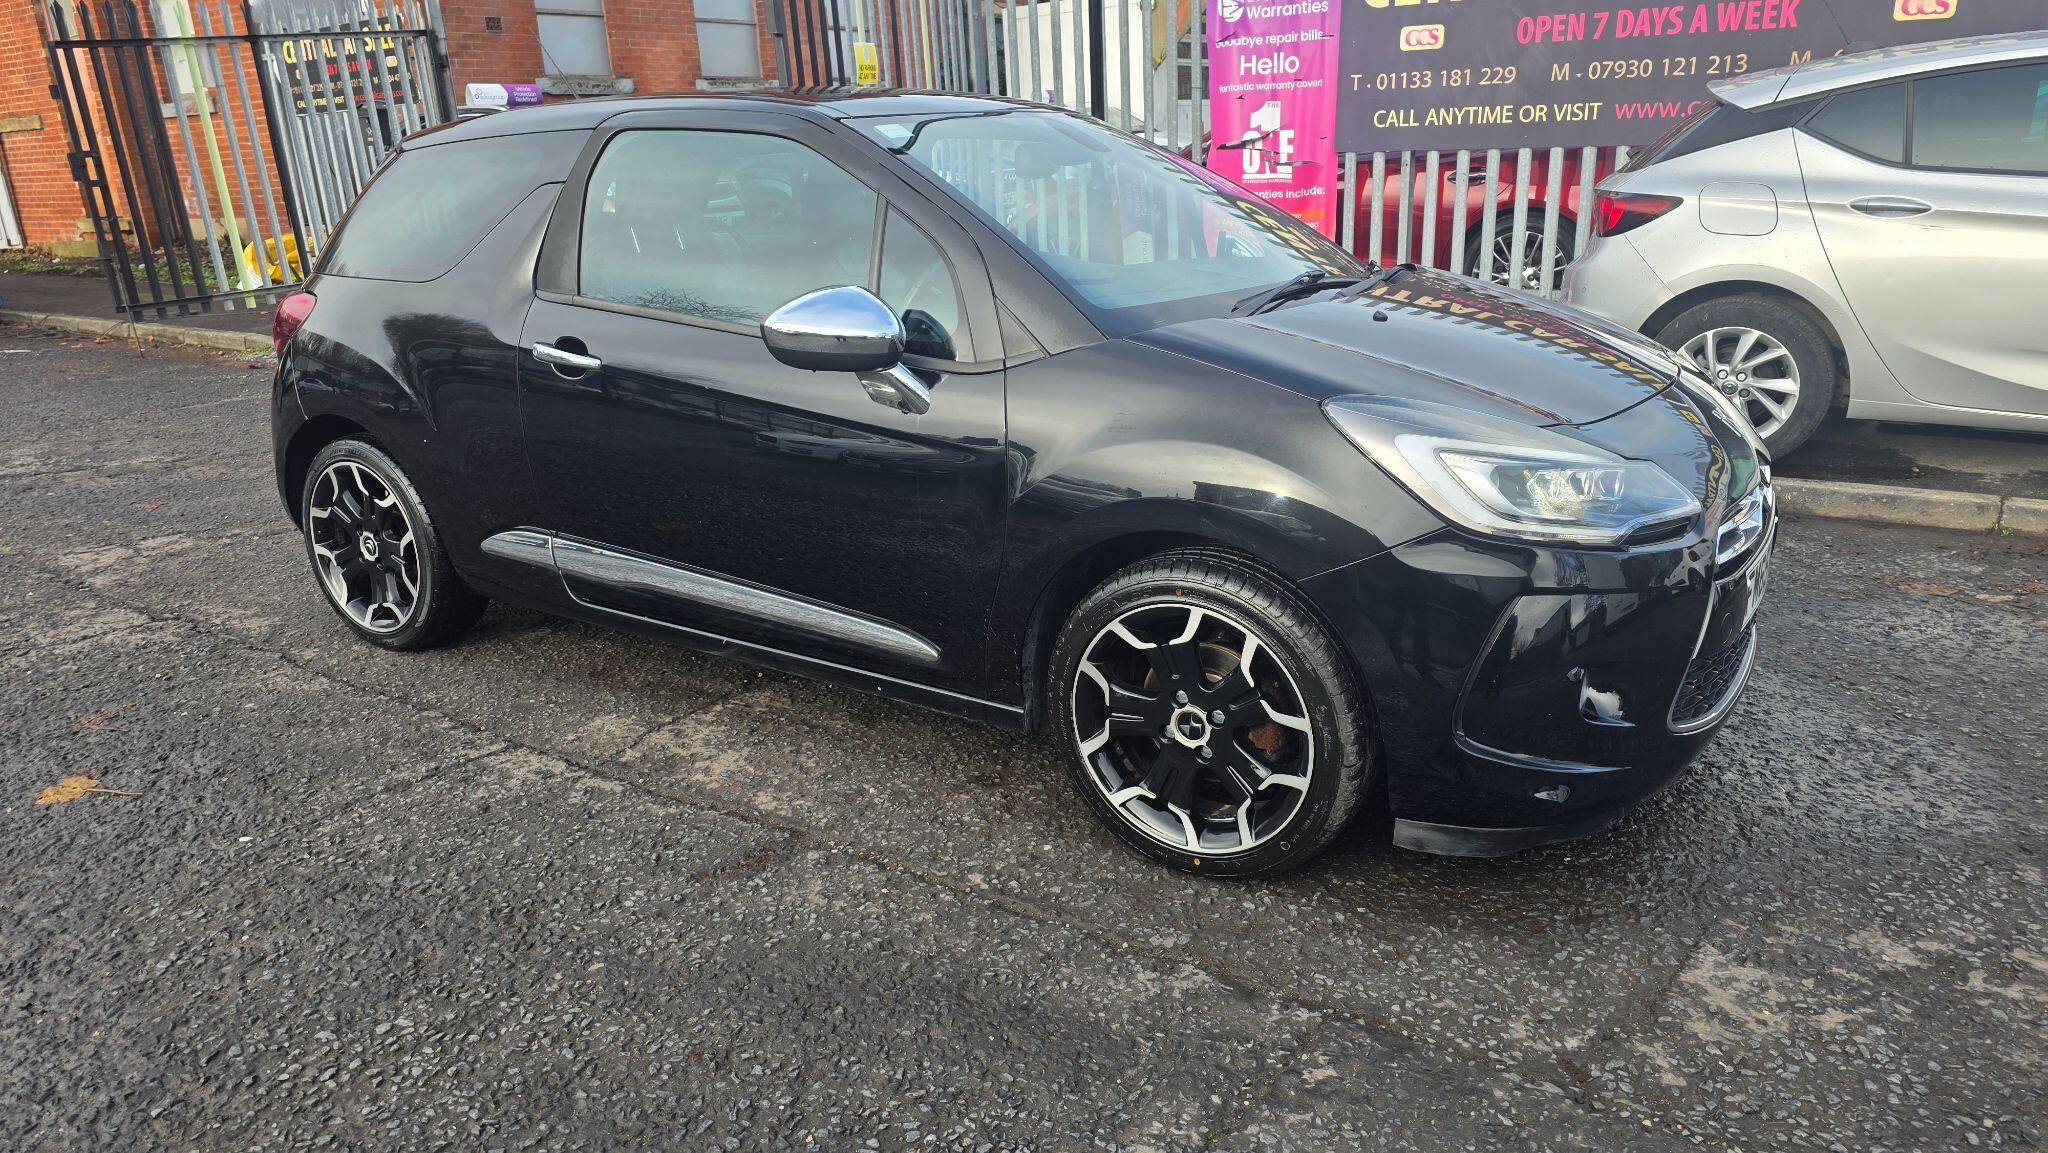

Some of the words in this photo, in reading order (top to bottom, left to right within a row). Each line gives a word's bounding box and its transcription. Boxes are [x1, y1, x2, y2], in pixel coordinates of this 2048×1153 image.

[1247, 1, 1328, 19] Warranties
[1516, 13, 1586, 44] OPEN
[1592, 12, 1609, 40] 7
[1615, 6, 1684, 39] DAYS
[1688, 3, 1707, 34] A
[1717, 0, 1800, 32] WEEK
[1265, 31, 1298, 47] repair
[1240, 51, 1300, 76] Hello
[1588, 59, 1653, 80] 07930
[1662, 56, 1697, 76] 121
[1706, 53, 1748, 74] 213
[1219, 82, 1254, 93] fantastic
[1255, 81, 1295, 92] warranty
[1376, 70, 1432, 91] 01133
[1440, 69, 1471, 87] 181
[1478, 66, 1517, 85] 229
[1373, 109, 1420, 128] CALL
[1424, 105, 1514, 126] ANYTIME
[1519, 104, 1547, 123] OR
[1554, 102, 1603, 122] VISIT
[1286, 186, 1326, 199] include:
